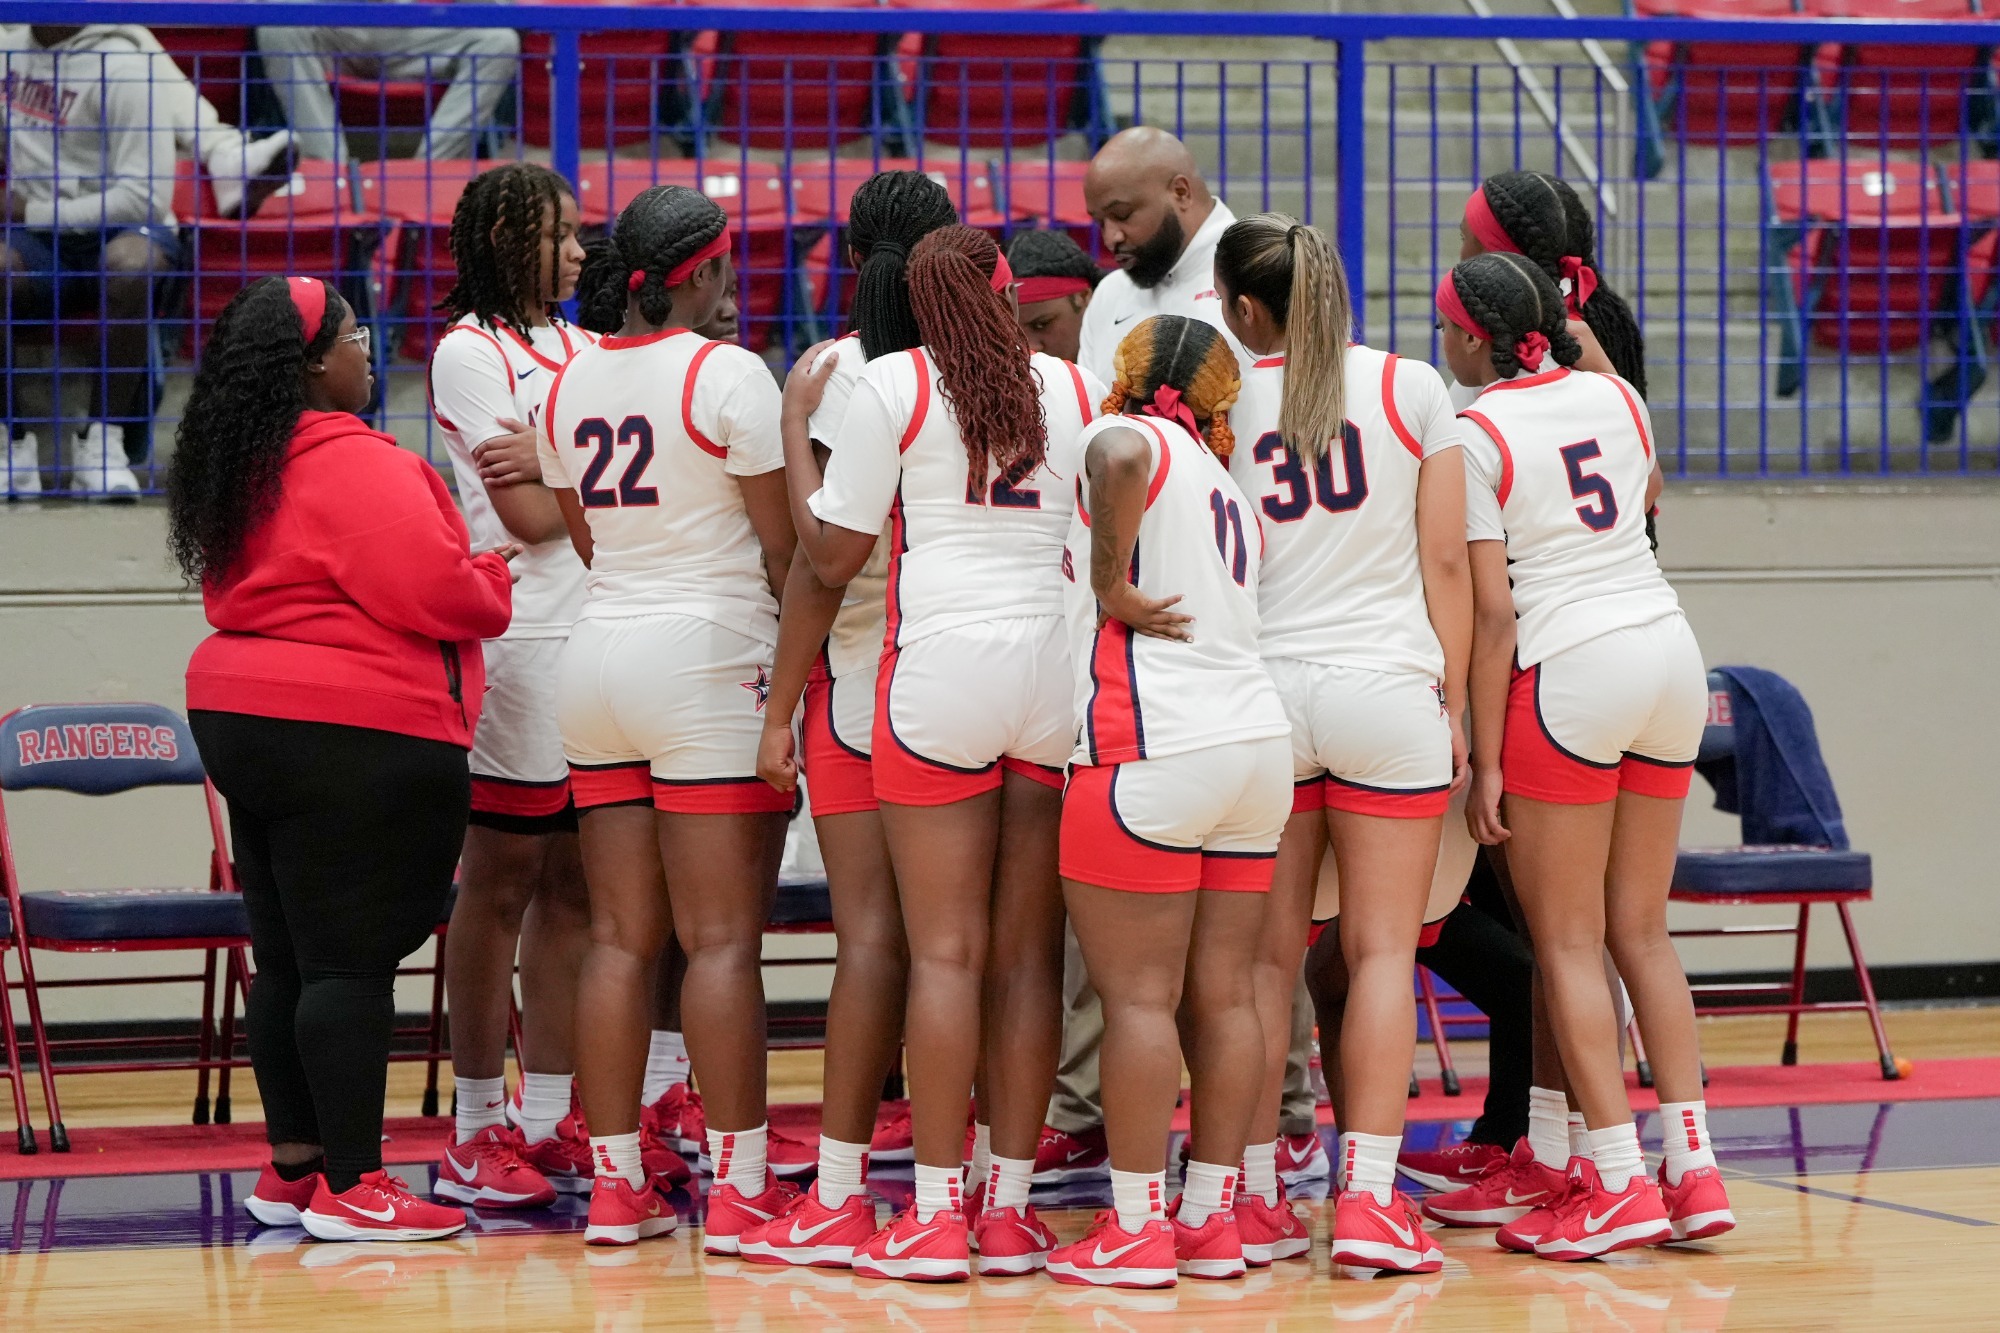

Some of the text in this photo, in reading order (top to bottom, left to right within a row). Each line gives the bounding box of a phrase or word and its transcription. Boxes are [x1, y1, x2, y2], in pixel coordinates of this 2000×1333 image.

[574, 414, 660, 508] 22
[1252, 417, 1369, 524] 30
[1559, 438, 1619, 533] 5
[1209, 487, 1248, 588] 11
[17, 723, 178, 766] RANGERS
